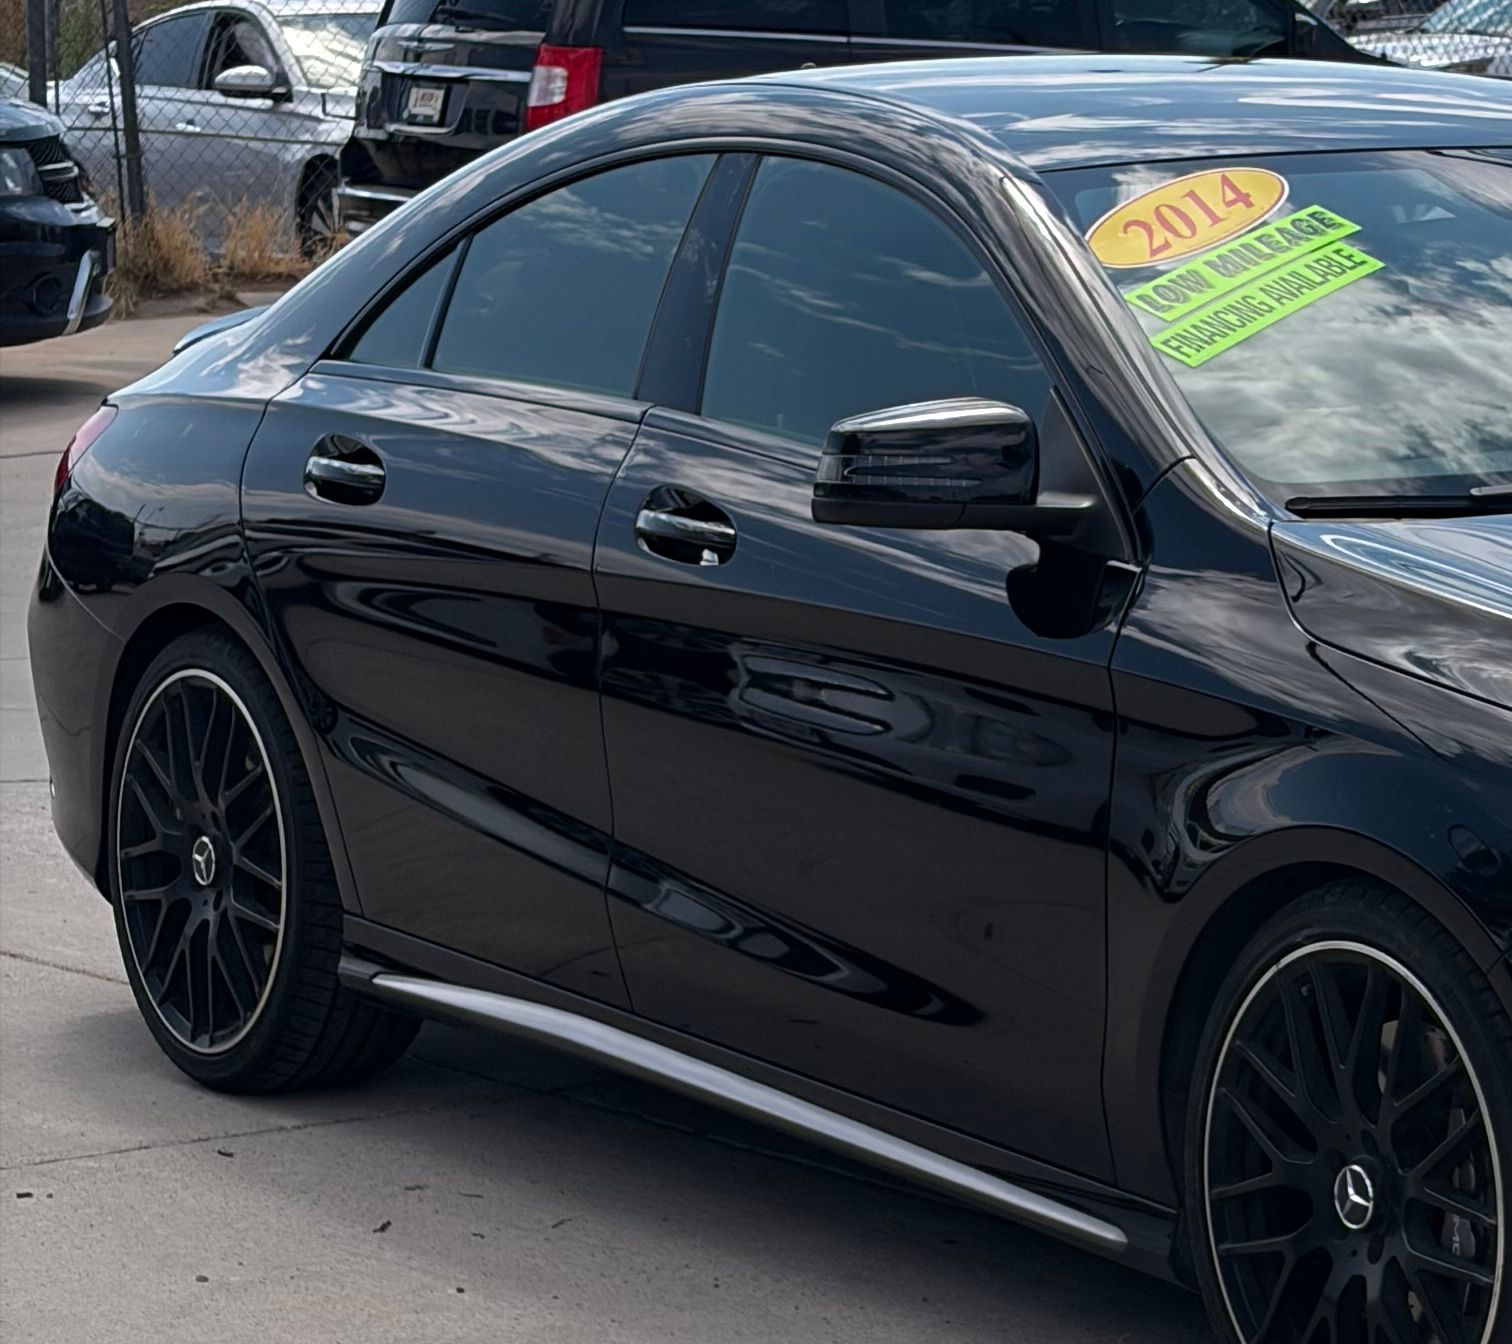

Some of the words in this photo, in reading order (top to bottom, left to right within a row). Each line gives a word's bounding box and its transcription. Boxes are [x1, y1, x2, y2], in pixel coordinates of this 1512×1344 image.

[1122, 173, 1256, 259] 2014
[1135, 268, 1216, 314] LOW
[1203, 209, 1348, 280] MILEAGE
[1160, 294, 1273, 359] FINANCING
[1263, 247, 1368, 314] AVAILABLE
